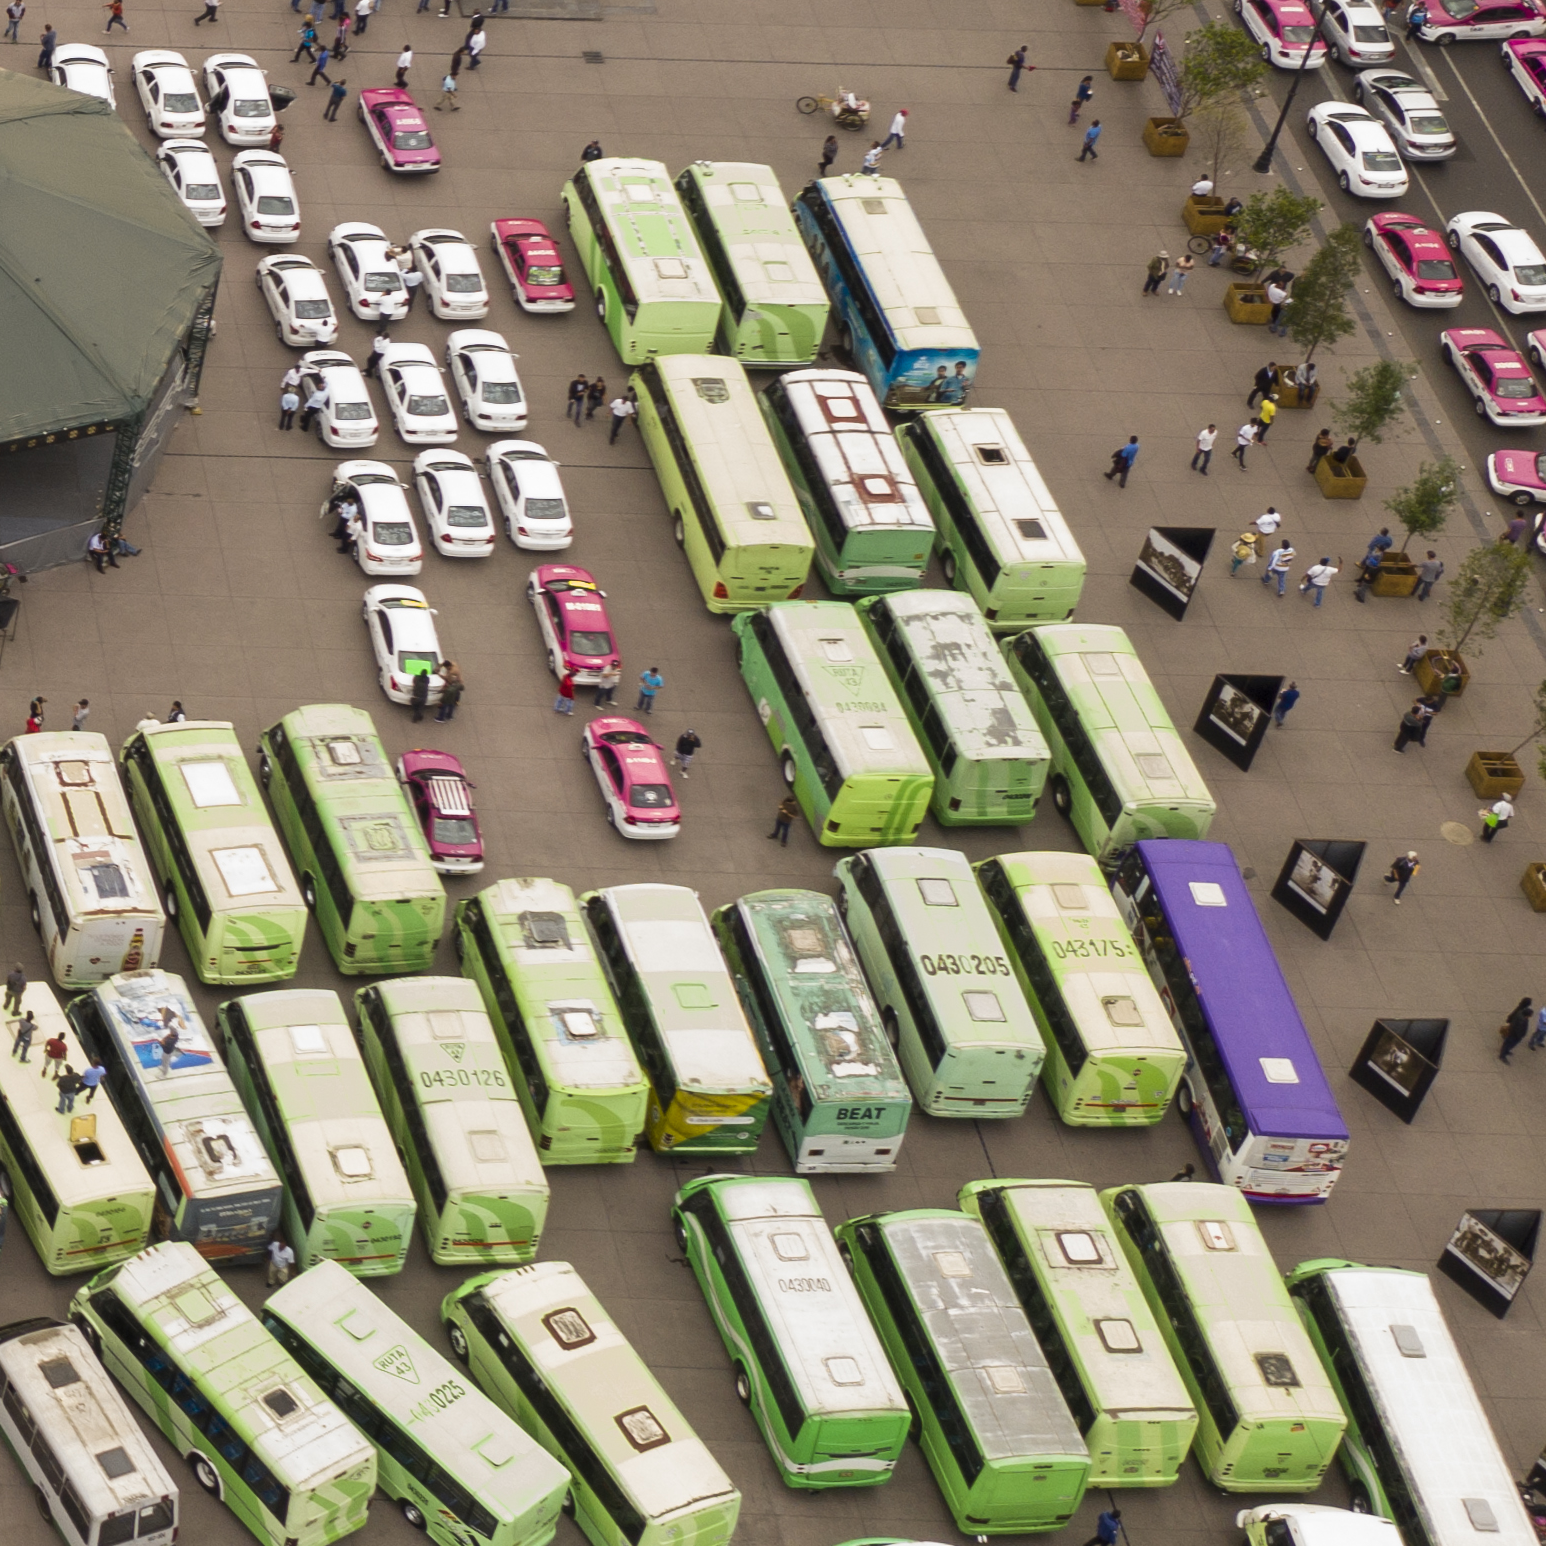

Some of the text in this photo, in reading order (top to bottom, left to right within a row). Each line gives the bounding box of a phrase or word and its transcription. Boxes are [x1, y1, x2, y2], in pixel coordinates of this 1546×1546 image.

[920, 954, 1010, 977] 0430205
[420, 1069, 506, 1088] 0430126
[836, 1108, 886, 1120] BEAT
[778, 1278, 831, 1293] 0430040
[378, 1349, 406, 1370] RUTA
[396, 1364, 412, 1376] 43
